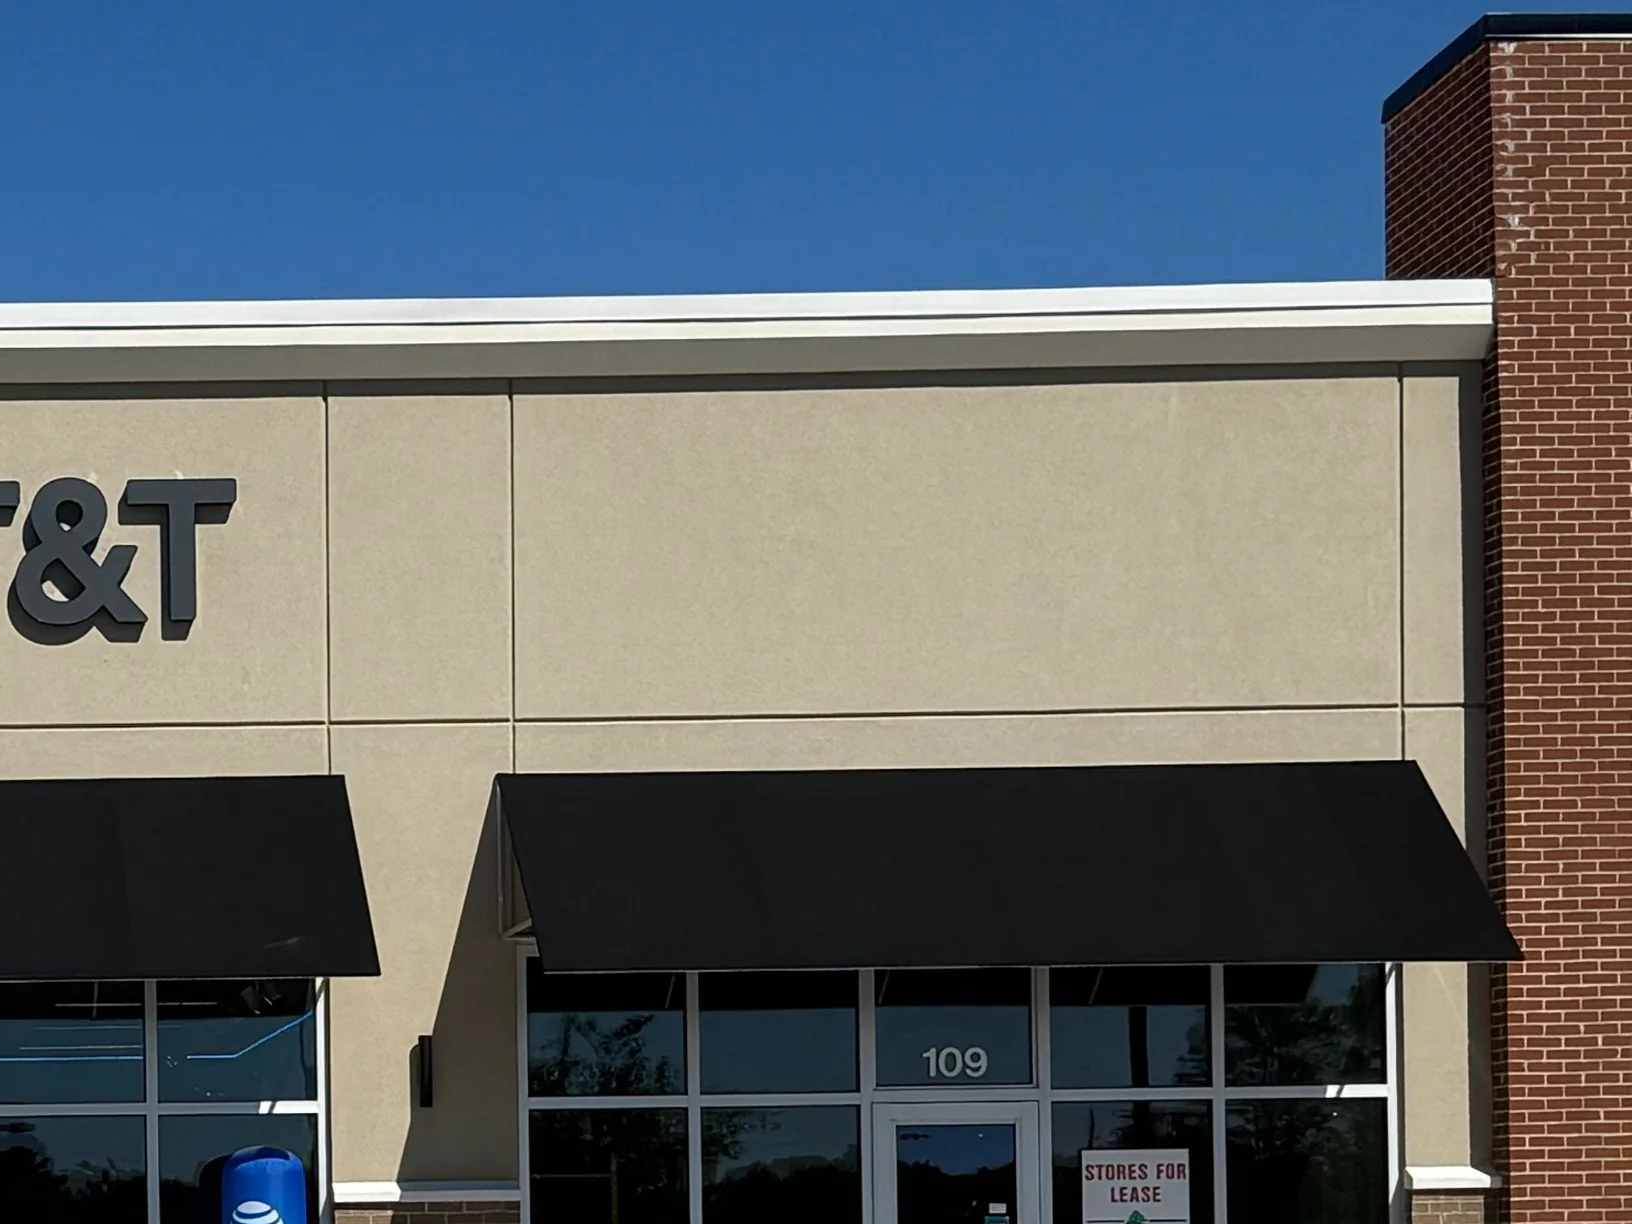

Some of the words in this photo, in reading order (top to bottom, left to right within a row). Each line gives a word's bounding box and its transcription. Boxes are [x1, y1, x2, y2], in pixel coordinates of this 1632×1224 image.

[922, 1046, 988, 1078] 109
[1084, 1164, 1149, 1181] STORES
[1156, 1163, 1187, 1180] FOR
[1110, 1186, 1162, 1203] LEASE
